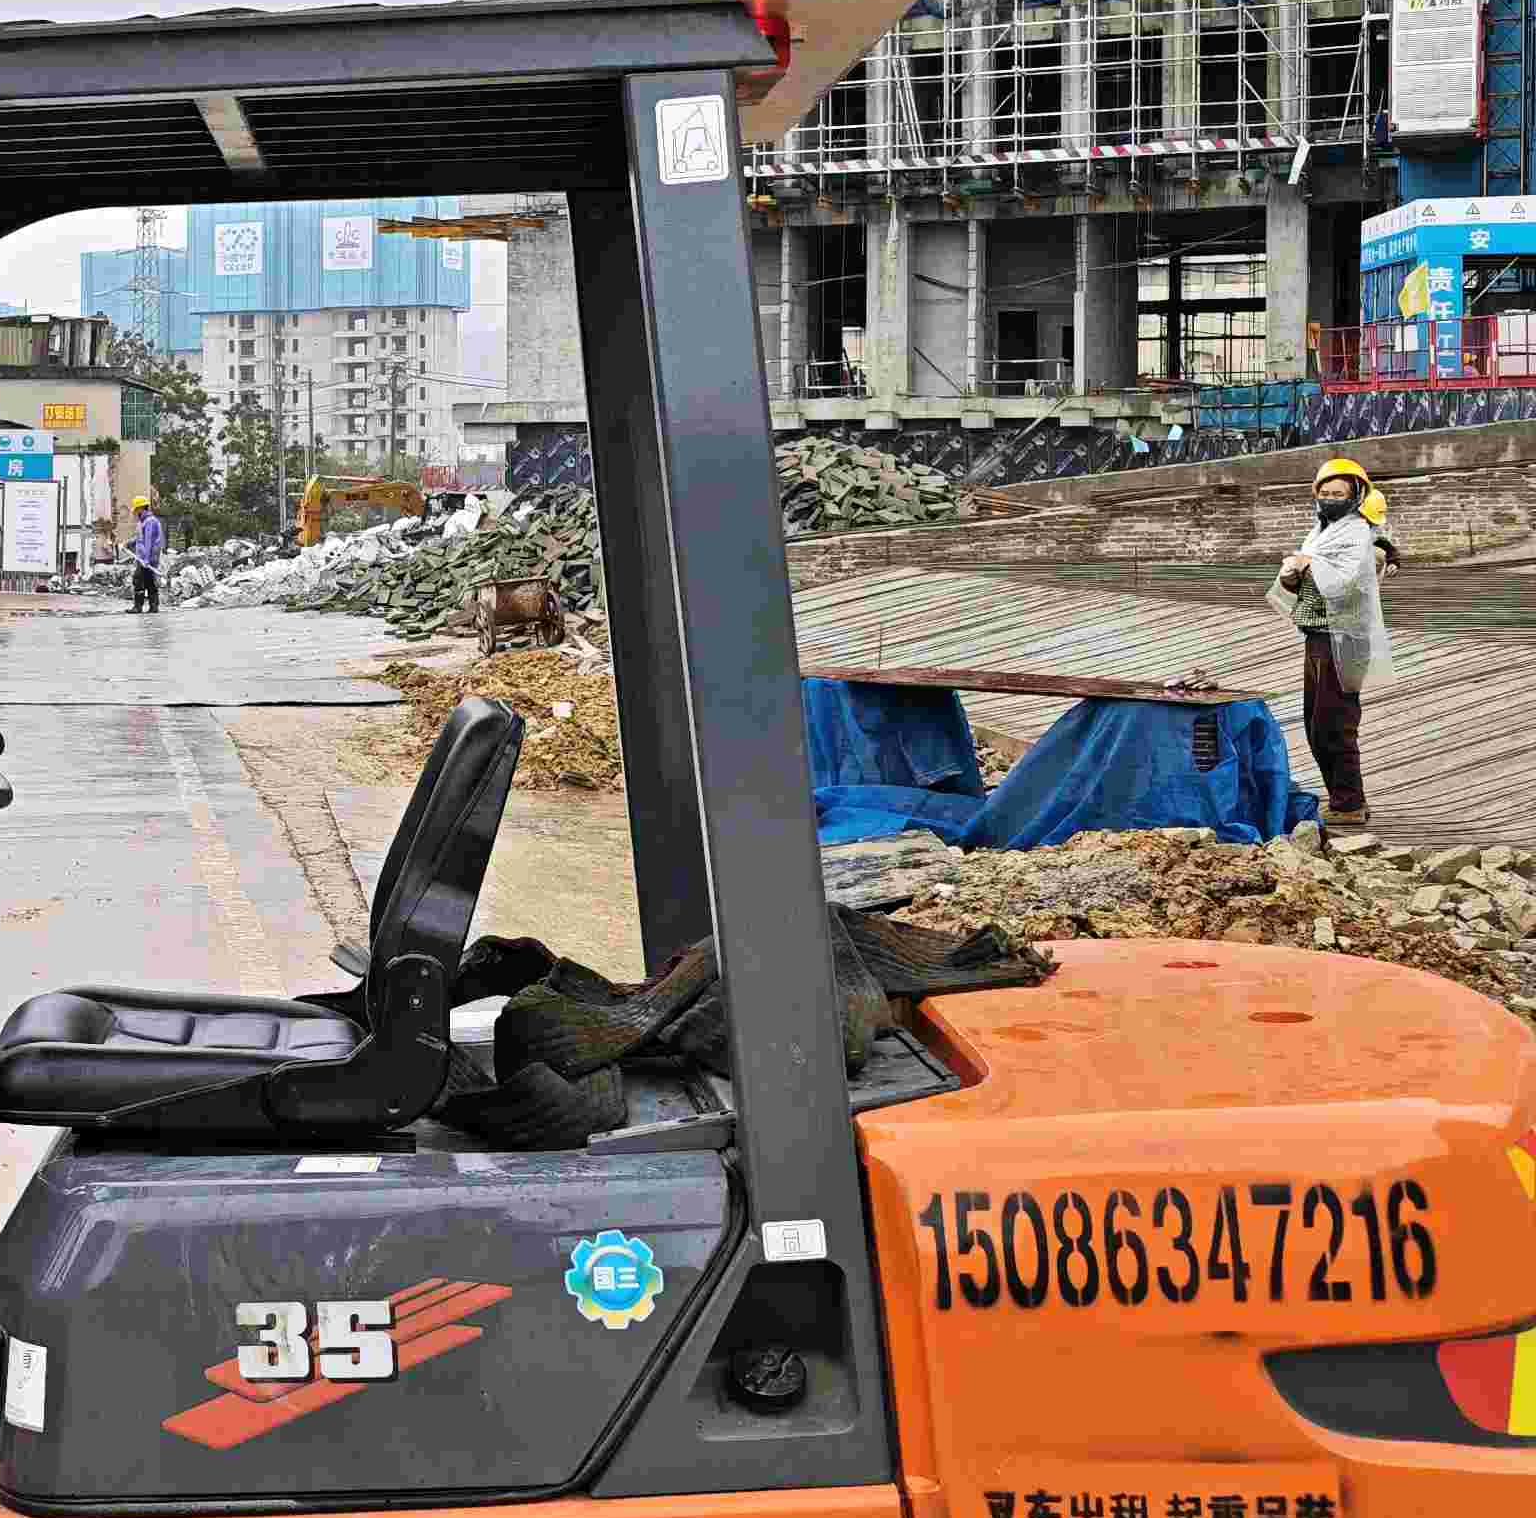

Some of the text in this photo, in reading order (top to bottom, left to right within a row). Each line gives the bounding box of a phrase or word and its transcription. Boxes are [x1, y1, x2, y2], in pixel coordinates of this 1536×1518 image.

[593, 1267, 640, 1291] 国三
[920, 1179, 1437, 1311] 15086347216
[235, 1300, 397, 1380] 35
